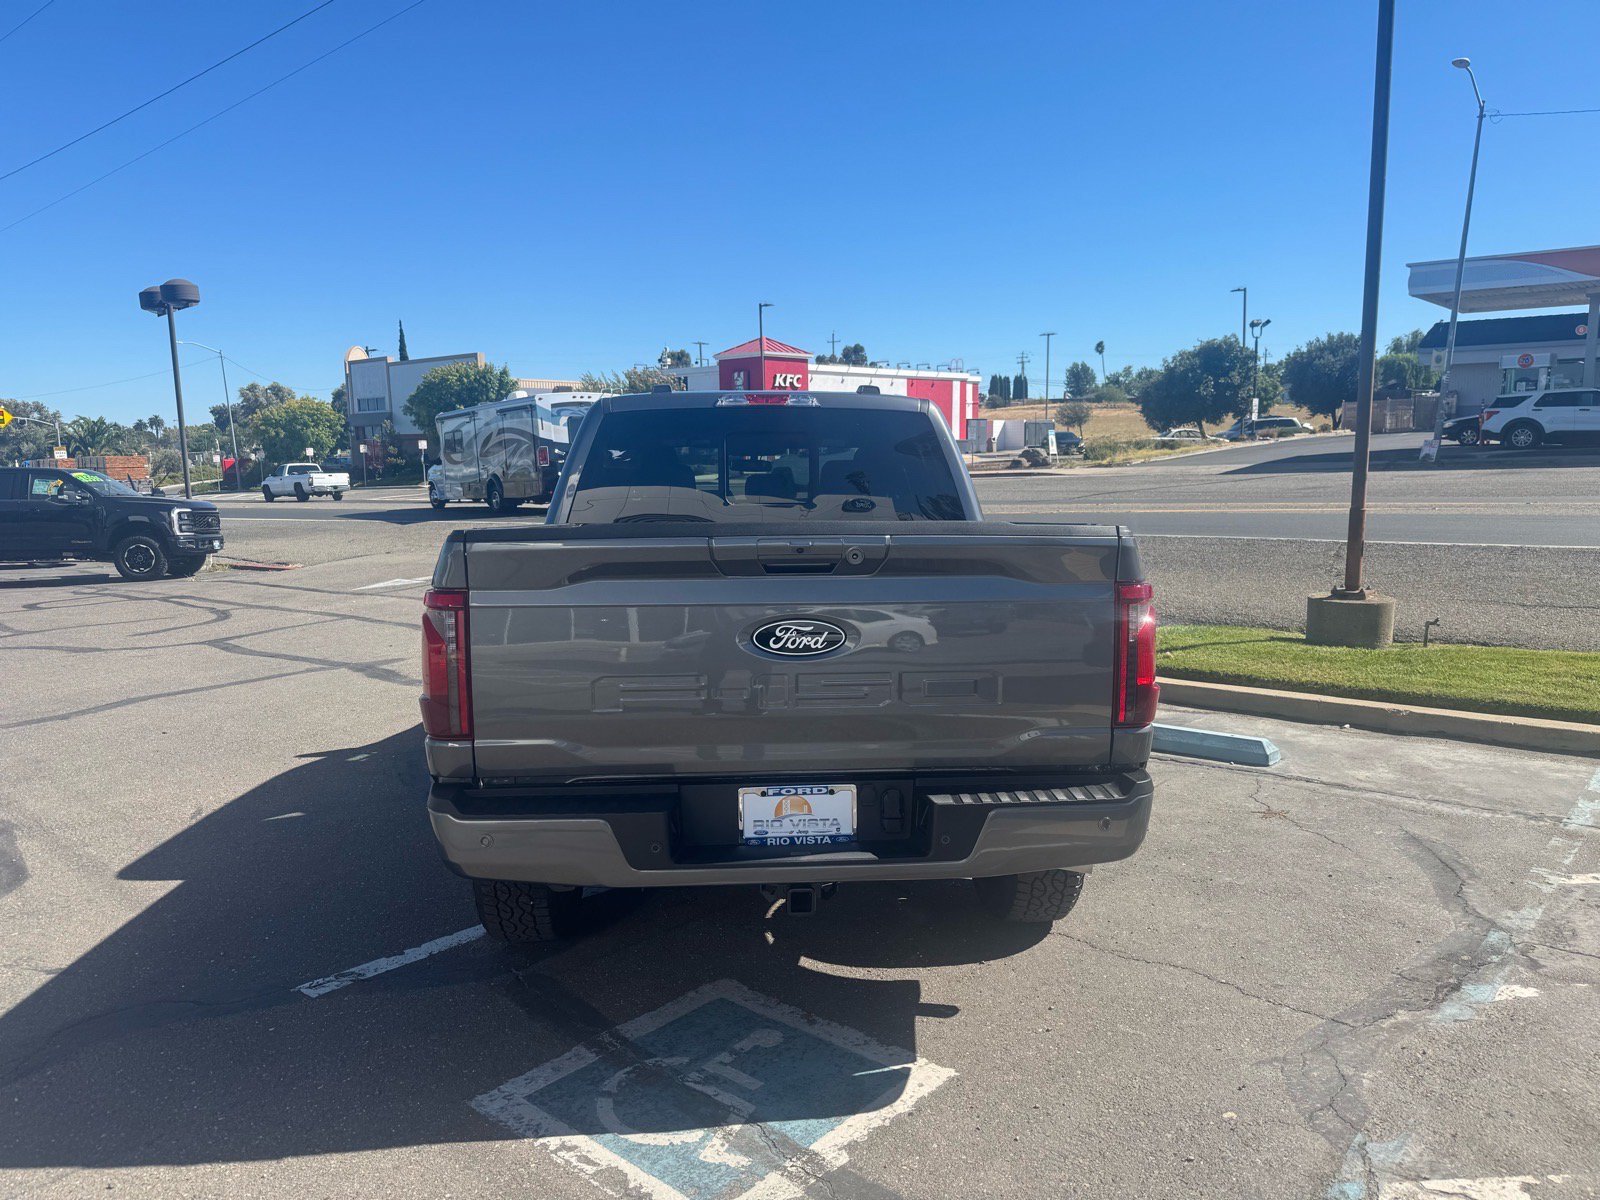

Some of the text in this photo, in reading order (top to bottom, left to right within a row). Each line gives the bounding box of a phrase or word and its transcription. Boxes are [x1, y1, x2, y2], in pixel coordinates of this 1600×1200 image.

[774, 373, 803, 388] KFC
[769, 625, 829, 649] Ford
[767, 786, 829, 796] FORD
[752, 817, 842, 829] RIO VISTA
[767, 837, 790, 846] RIO
[794, 836, 832, 845] VISTA
